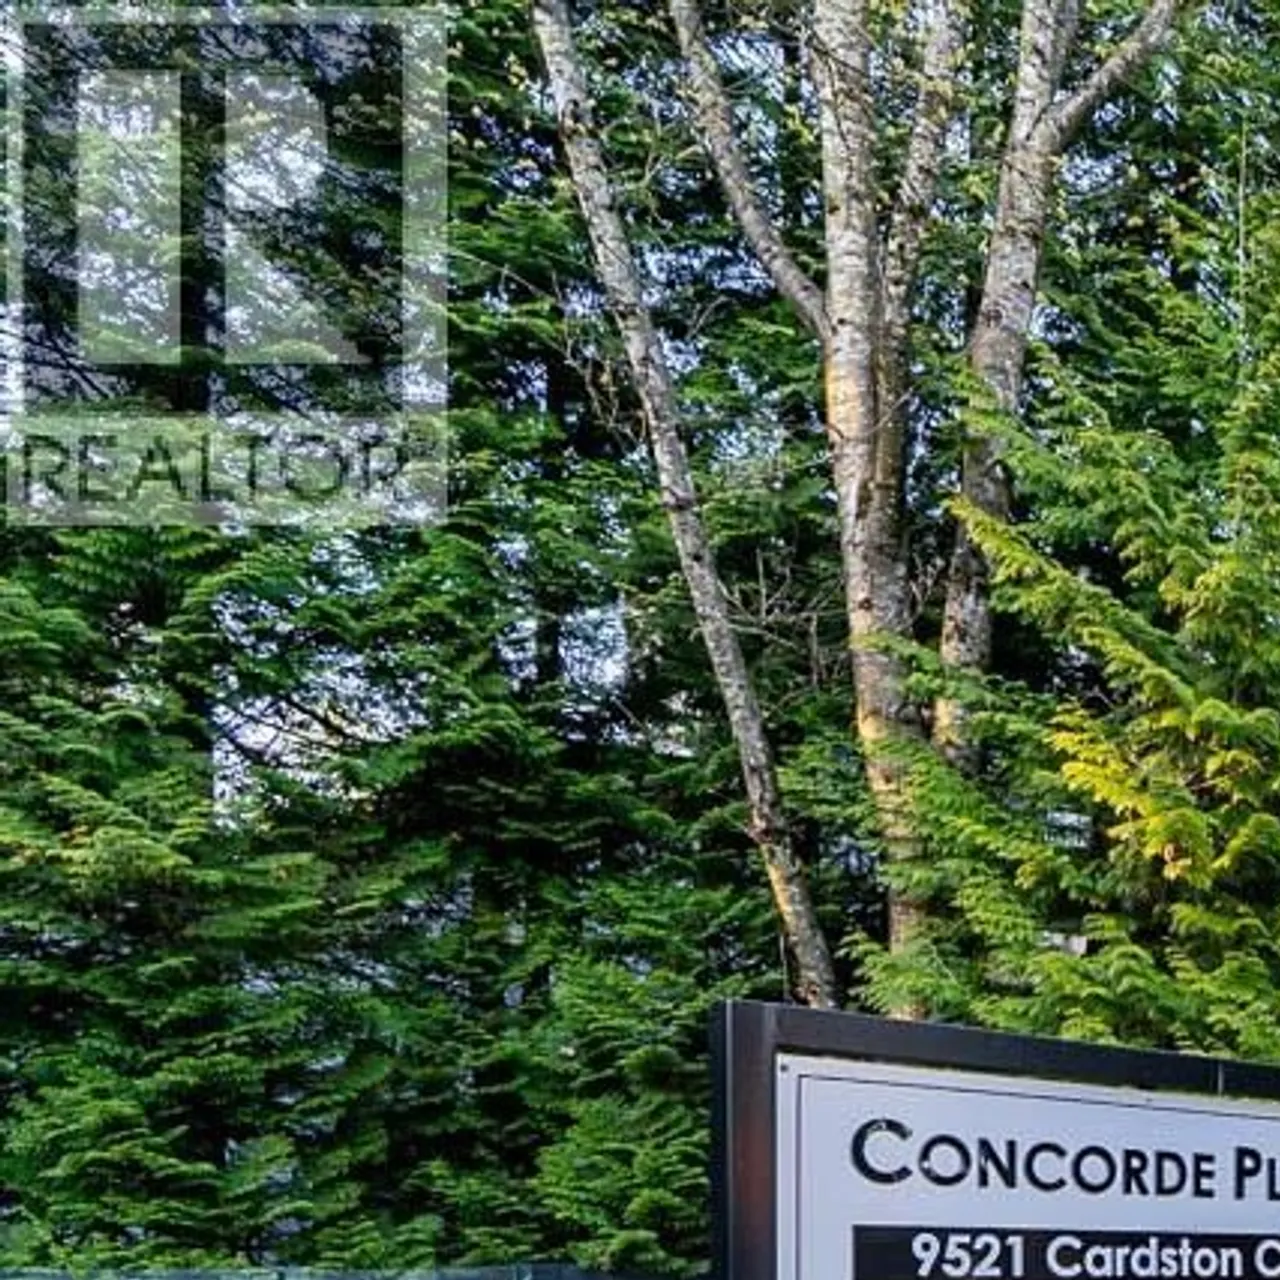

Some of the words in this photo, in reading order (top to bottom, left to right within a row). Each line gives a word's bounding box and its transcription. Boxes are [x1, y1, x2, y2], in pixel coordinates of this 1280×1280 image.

[852, 1117, 1216, 1199] CONCORDE
[911, 1232, 1025, 1278] 9521
[1046, 1235, 1243, 1278] Cardston
